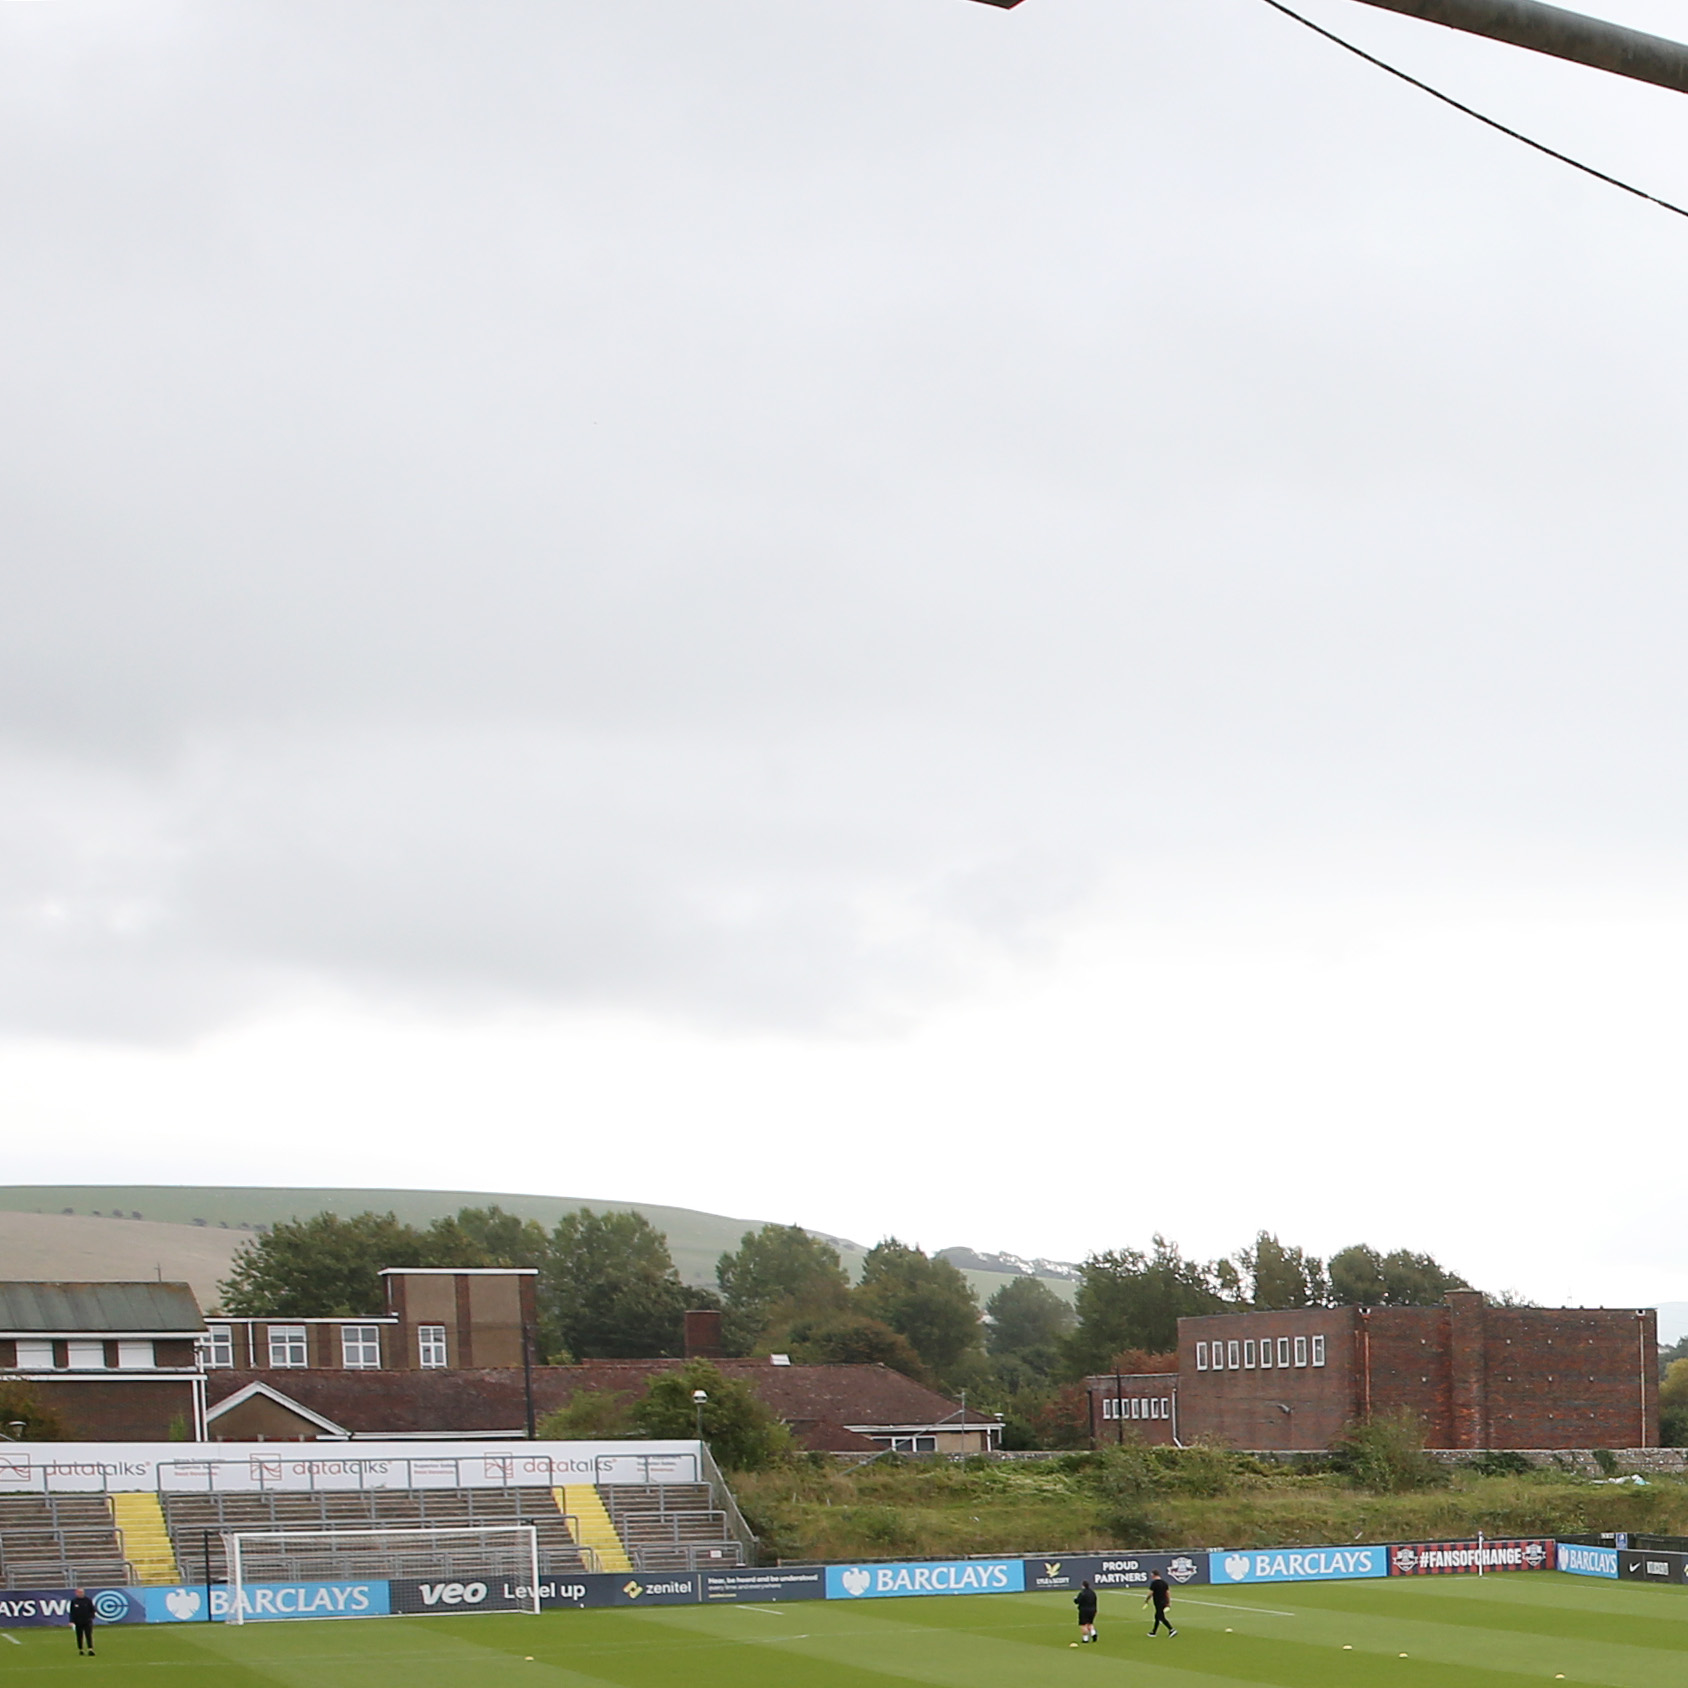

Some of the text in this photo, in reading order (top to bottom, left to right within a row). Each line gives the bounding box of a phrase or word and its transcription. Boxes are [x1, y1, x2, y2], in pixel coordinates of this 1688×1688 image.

[47, 1459, 147, 1477] datatalks
[293, 1461, 389, 1476] datatalks
[523, 1459, 613, 1473] datatalks
[1103, 1561, 1138, 1571] PROUD
[1255, 1551, 1372, 1577] BARCLAYS
[1570, 1551, 1617, 1573] BARCLAYS
[876, 1564, 1007, 1591] BARCLAYS
[1095, 1572, 1147, 1583] PARTNERS
[419, 1581, 488, 1605] veo
[503, 1582, 586, 1601] Level up
[646, 1581, 692, 1595] zenitel
[211, 1585, 369, 1616] BARCLAYS
